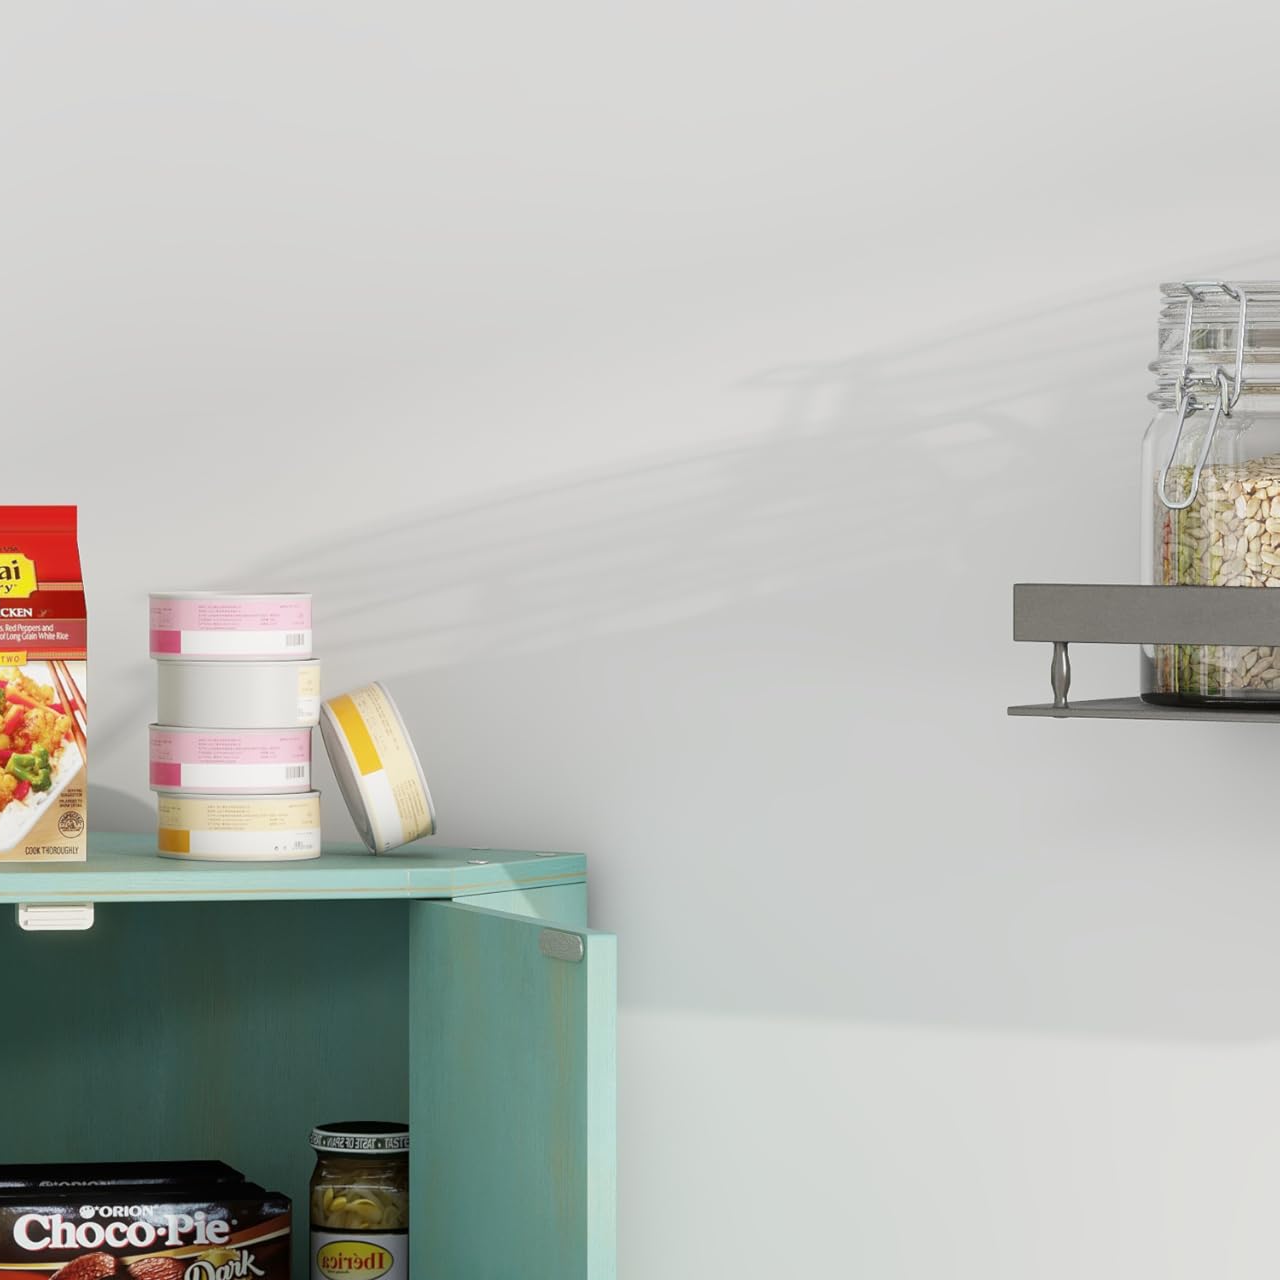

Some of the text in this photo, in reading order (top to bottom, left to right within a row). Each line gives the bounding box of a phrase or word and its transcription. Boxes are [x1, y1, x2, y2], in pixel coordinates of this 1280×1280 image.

[1, 655, 20, 663] TWO
[25, 846, 79, 855] COOK THOROUGHLY
[100, 1205, 153, 1218] ORION
